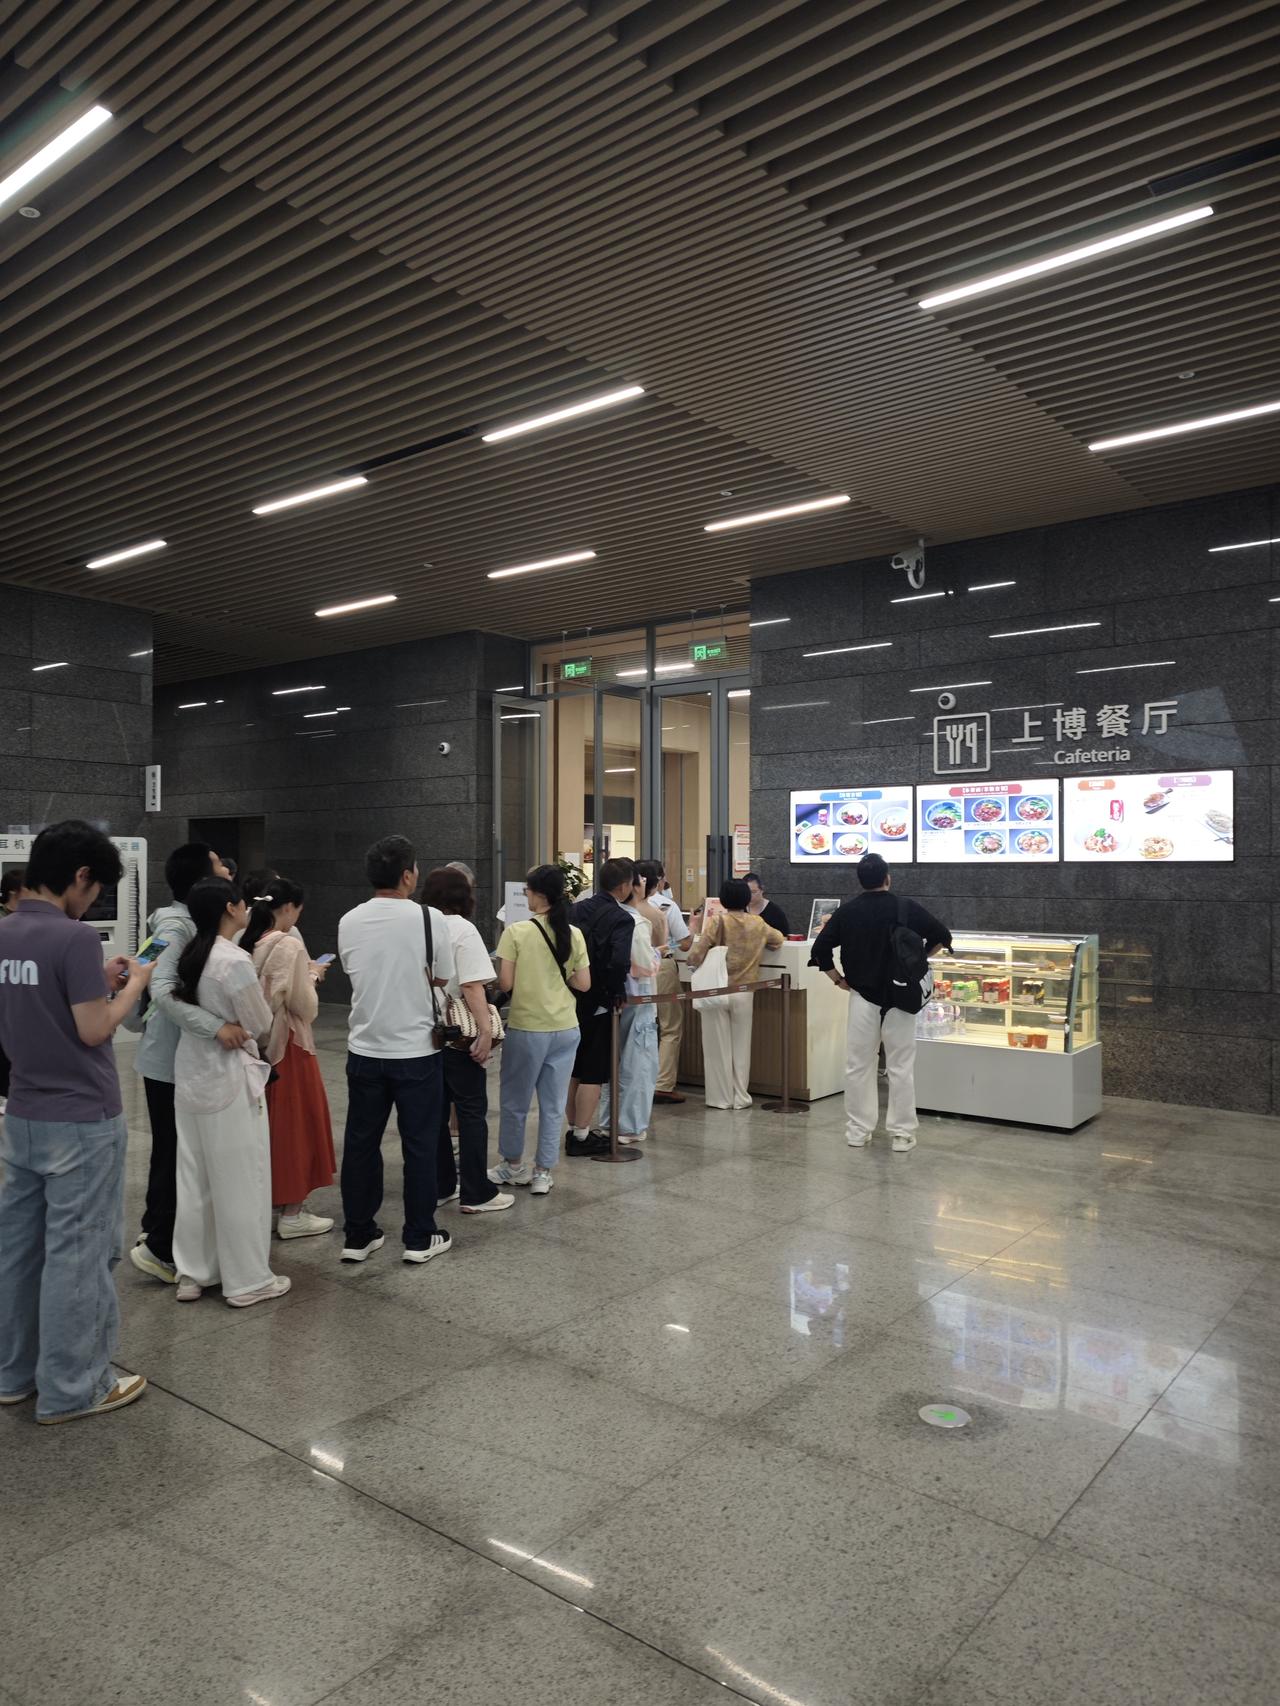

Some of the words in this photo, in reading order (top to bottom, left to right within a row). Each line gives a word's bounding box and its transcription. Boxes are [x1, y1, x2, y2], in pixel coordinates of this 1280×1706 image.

[1012, 701, 1178, 743] 上博餐厅
[1054, 747, 1131, 765] Cafeteria
[0, 839, 34, 850] 耳机
